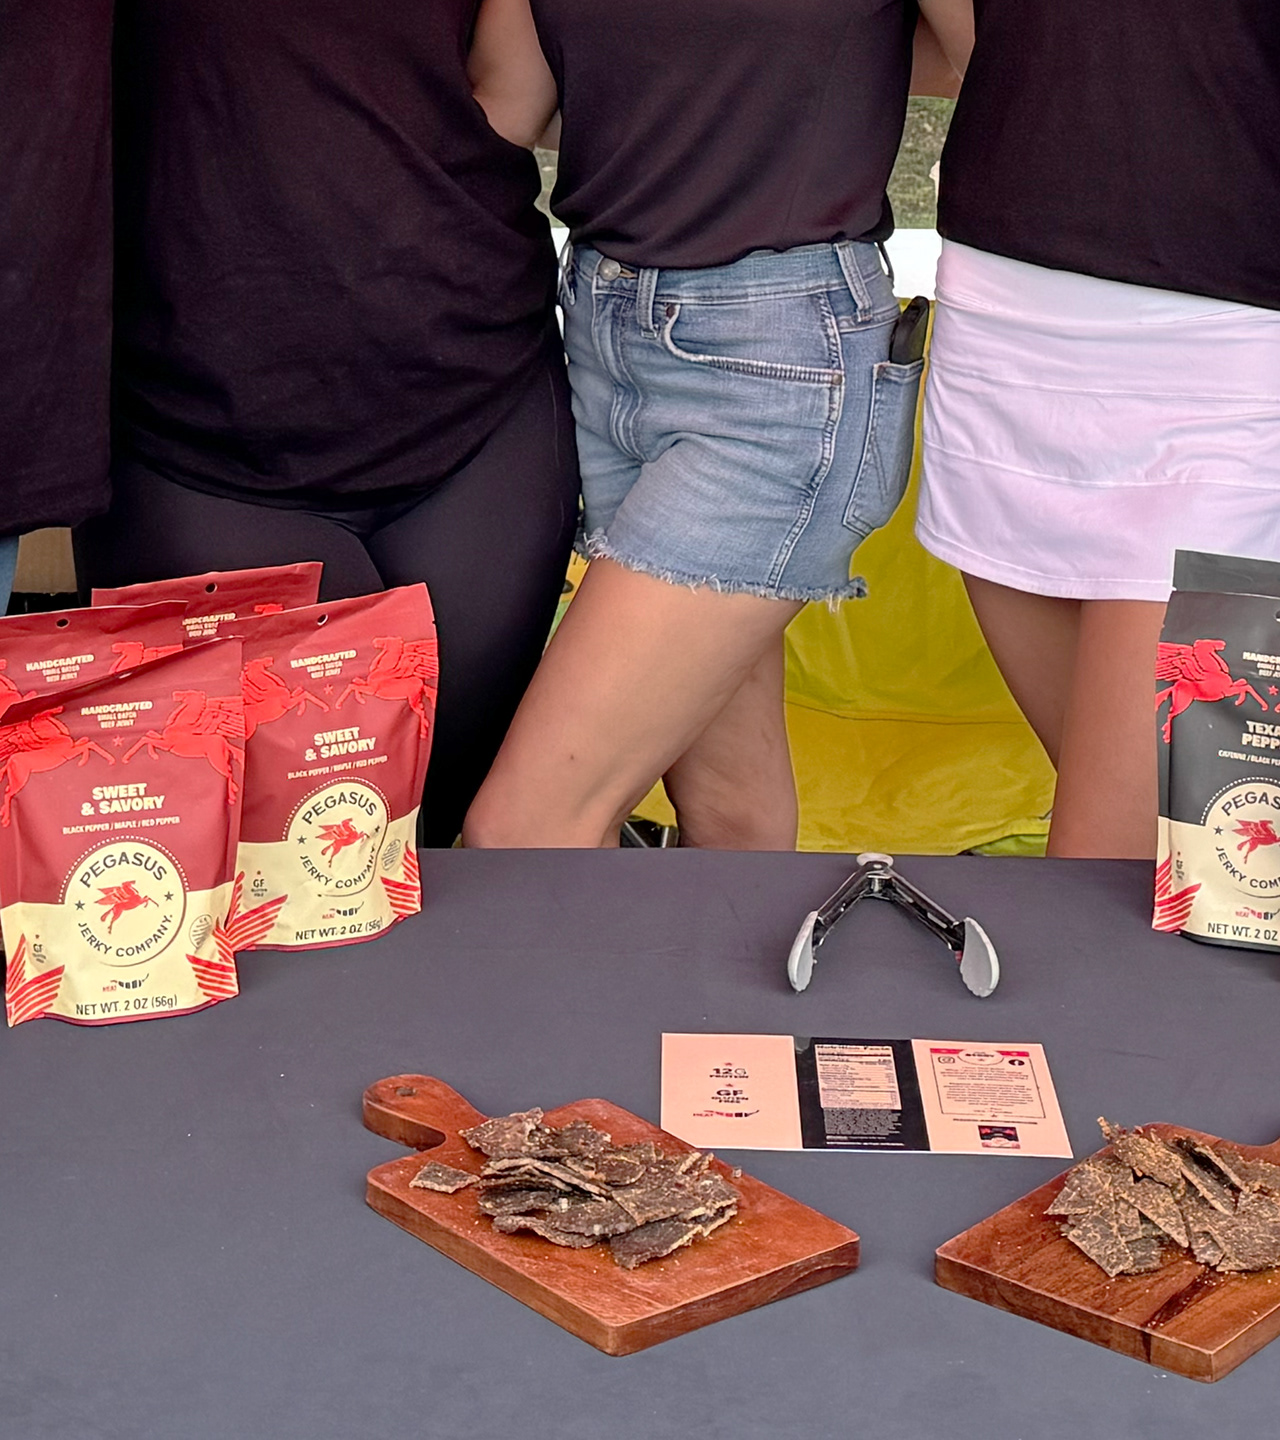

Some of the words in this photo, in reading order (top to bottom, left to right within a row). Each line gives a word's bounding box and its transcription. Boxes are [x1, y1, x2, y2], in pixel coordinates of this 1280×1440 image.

[26, 654, 94, 672] HANDCRAFTED
[291, 650, 356, 669] HANDCRAFTED
[81, 701, 152, 716] HANDCRAFTED
[314, 727, 360, 746] SWEET
[305, 749, 317, 761] &
[321, 737, 376, 759] SAVORY
[92, 784, 147, 800] SWEET
[81, 803, 94, 816] &
[99, 796, 165, 813] SAVORY
[302, 791, 378, 825] PEGASUS
[63, 826, 84, 835] BLACK
[85, 822, 109, 833] PEPPER
[80, 852, 168, 888] PEGASUS
[300, 855, 332, 887] JERKY
[335, 847, 375, 889] COMPANY
[1216, 847, 1247, 882] JERKY
[253, 879, 265, 888] GF
[78, 922, 112, 955] JERKY
[295, 930, 316, 941] NET
[341, 926, 346, 935] 2
[349, 924, 363, 934] OZ
[1208, 922, 1229, 934] NET
[1255, 929, 1260, 939] 2
[1264, 930, 1278, 941] OZ
[76, 1002, 97, 1016] NET
[124, 1000, 130, 1011] 2
[133, 998, 148, 1010] OZ
[152, 995, 178, 1008] (56g)
